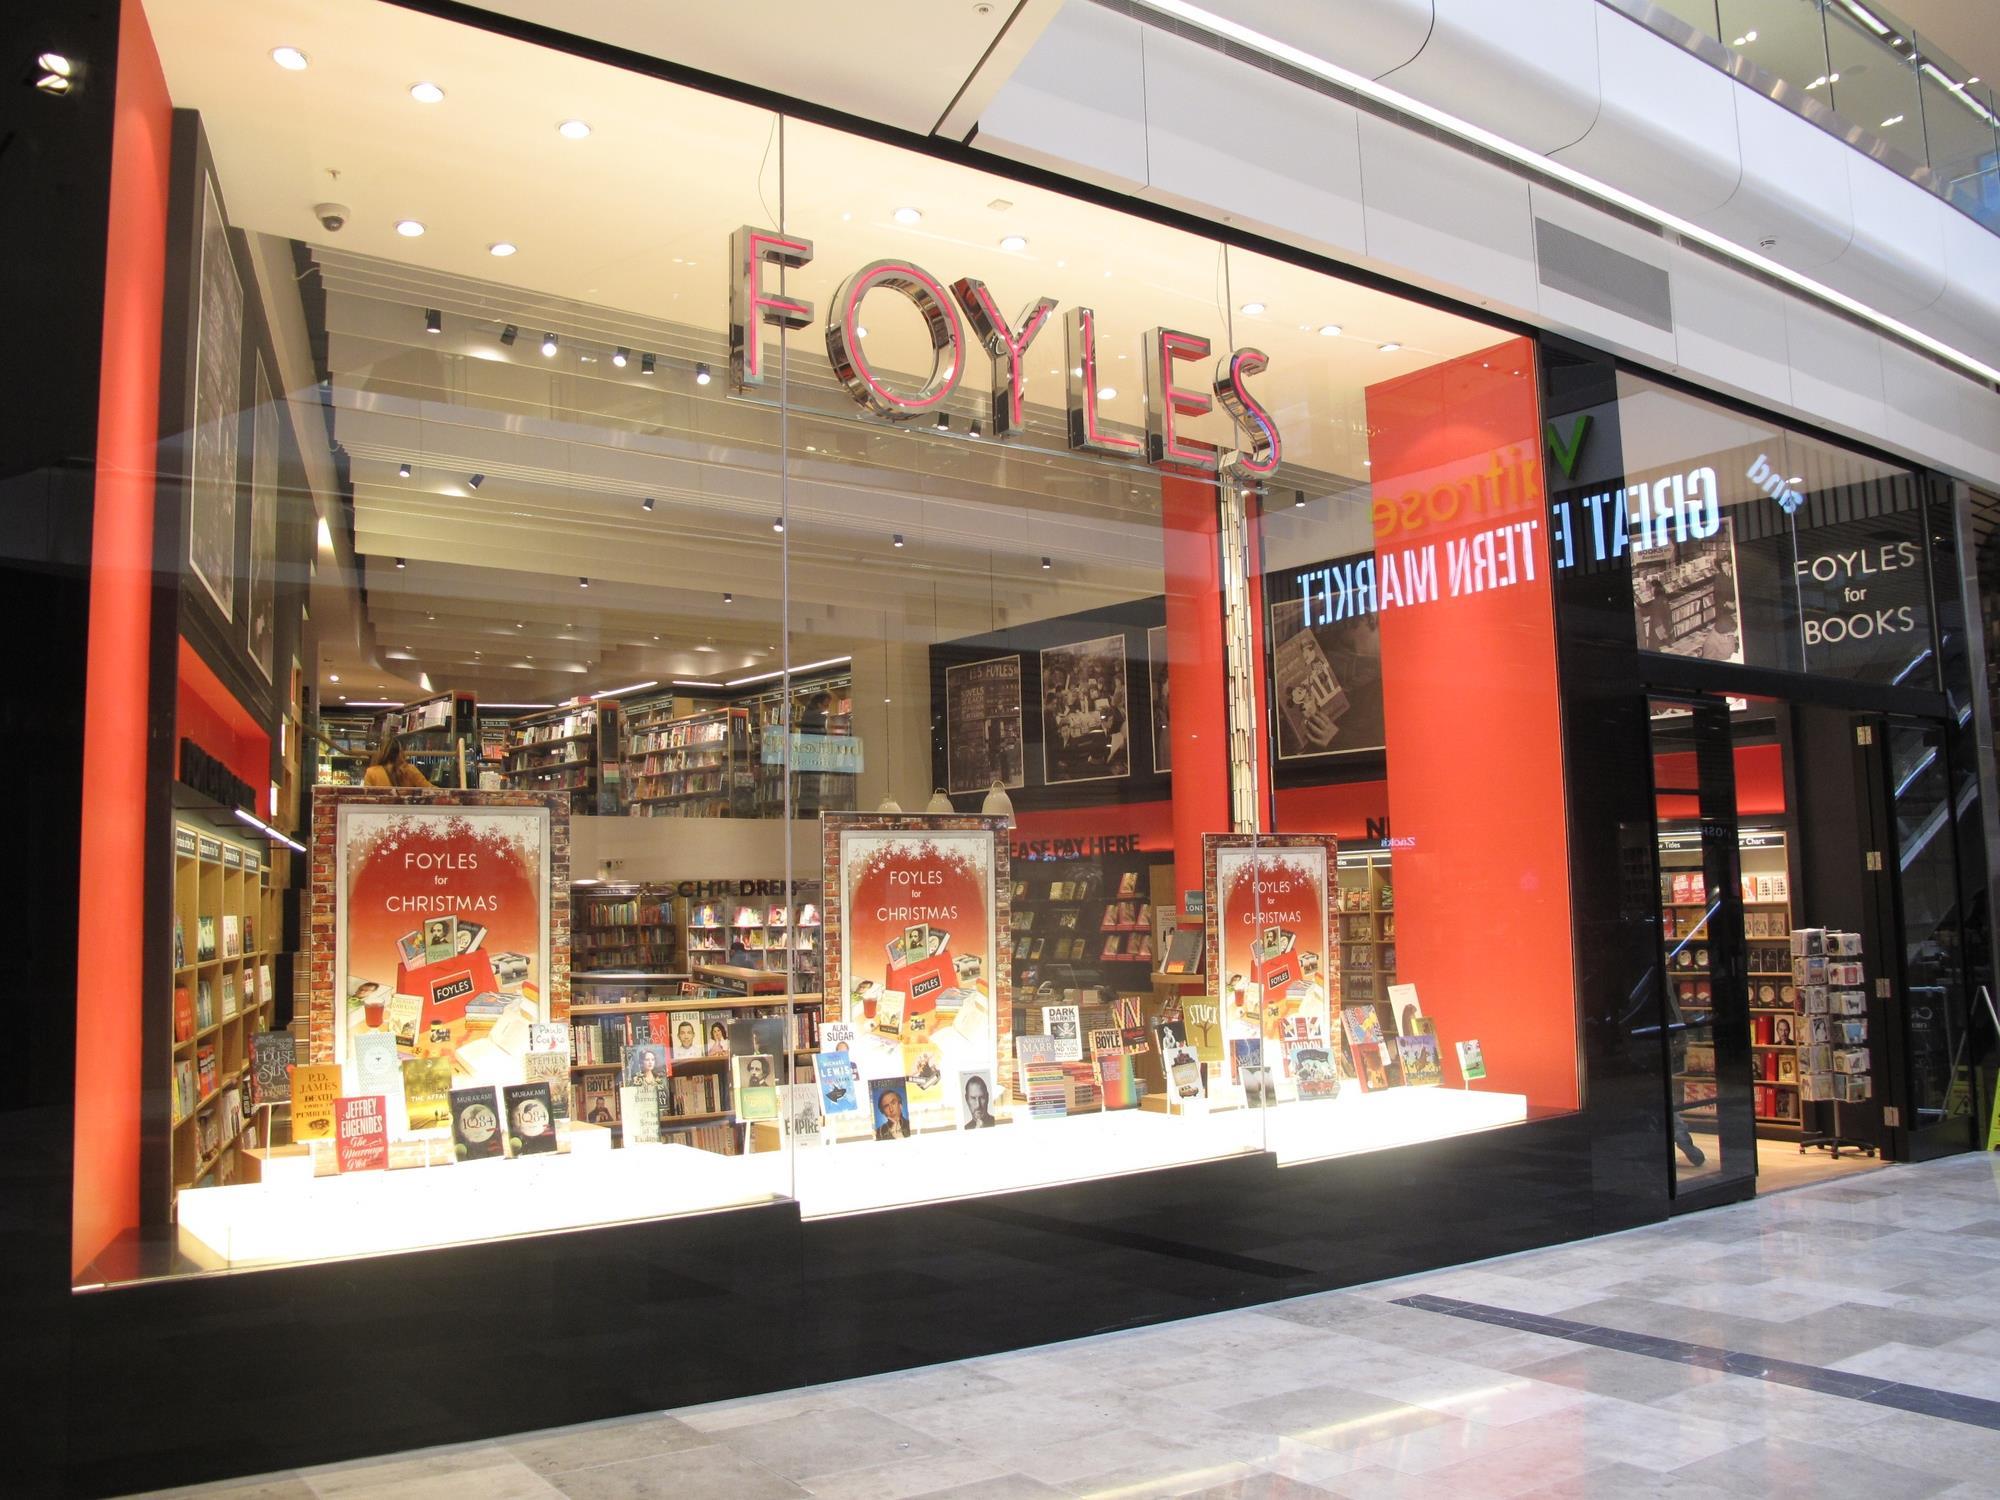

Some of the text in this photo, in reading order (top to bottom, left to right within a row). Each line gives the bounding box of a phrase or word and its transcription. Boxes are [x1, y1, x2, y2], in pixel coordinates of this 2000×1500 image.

[729, 225, 1281, 480] FOYLES
[1794, 541, 1915, 583] FOYLES
[1844, 587, 1867, 603] for
[1804, 606, 1915, 646] BOOKS
[1054, 838, 1085, 857] PAY
[1089, 833, 1141, 855] HERE
[1745, 837, 1765, 846] Chart
[405, 853, 478, 869] FOYLES
[434, 875, 448, 885] for
[889, 870, 943, 885] FOYLES
[911, 890, 922, 898] for
[1252, 881, 1290, 894] FOYLES
[386, 895, 498, 912] CHRISTMAS
[1267, 897, 1275, 905] for
[877, 905, 958, 922] CHRISTMAS
[1243, 910, 1302, 925] CHRISTMAS
[436, 980, 470, 999] FOYLES
[914, 978, 939, 994] FOYLES
[1049, 1008, 1075, 1016] DARK
[1189, 1004, 1218, 1025] STUCK
[636, 1025, 665, 1039] FEAR
[832, 1024, 849, 1032] ALAN
[827, 1031, 854, 1042] SUGAR
[1096, 1036, 1121, 1049] BOYLE
[1022, 1042, 1051, 1053] MARR
[528, 1055, 567, 1066] STEPHEN
[308, 1073, 329, 1082] P.D.
[821, 1065, 850, 1078] LEWIS
[300, 1082, 338, 1094] JAMES
[587, 1080, 613, 1092] BOYLE
[304, 1093, 333, 1103] DEATH
[426, 1092, 448, 1101] AFFAI
[456, 1093, 493, 1104] MURAKAMI
[511, 1089, 547, 1099] MURAKAMI
[345, 1098, 377, 1119] JEFFREY
[518, 1110, 547, 1124] 1Q84
[341, 1115, 383, 1139] EUGENIDES
[463, 1118, 494, 1130] 1Q84
